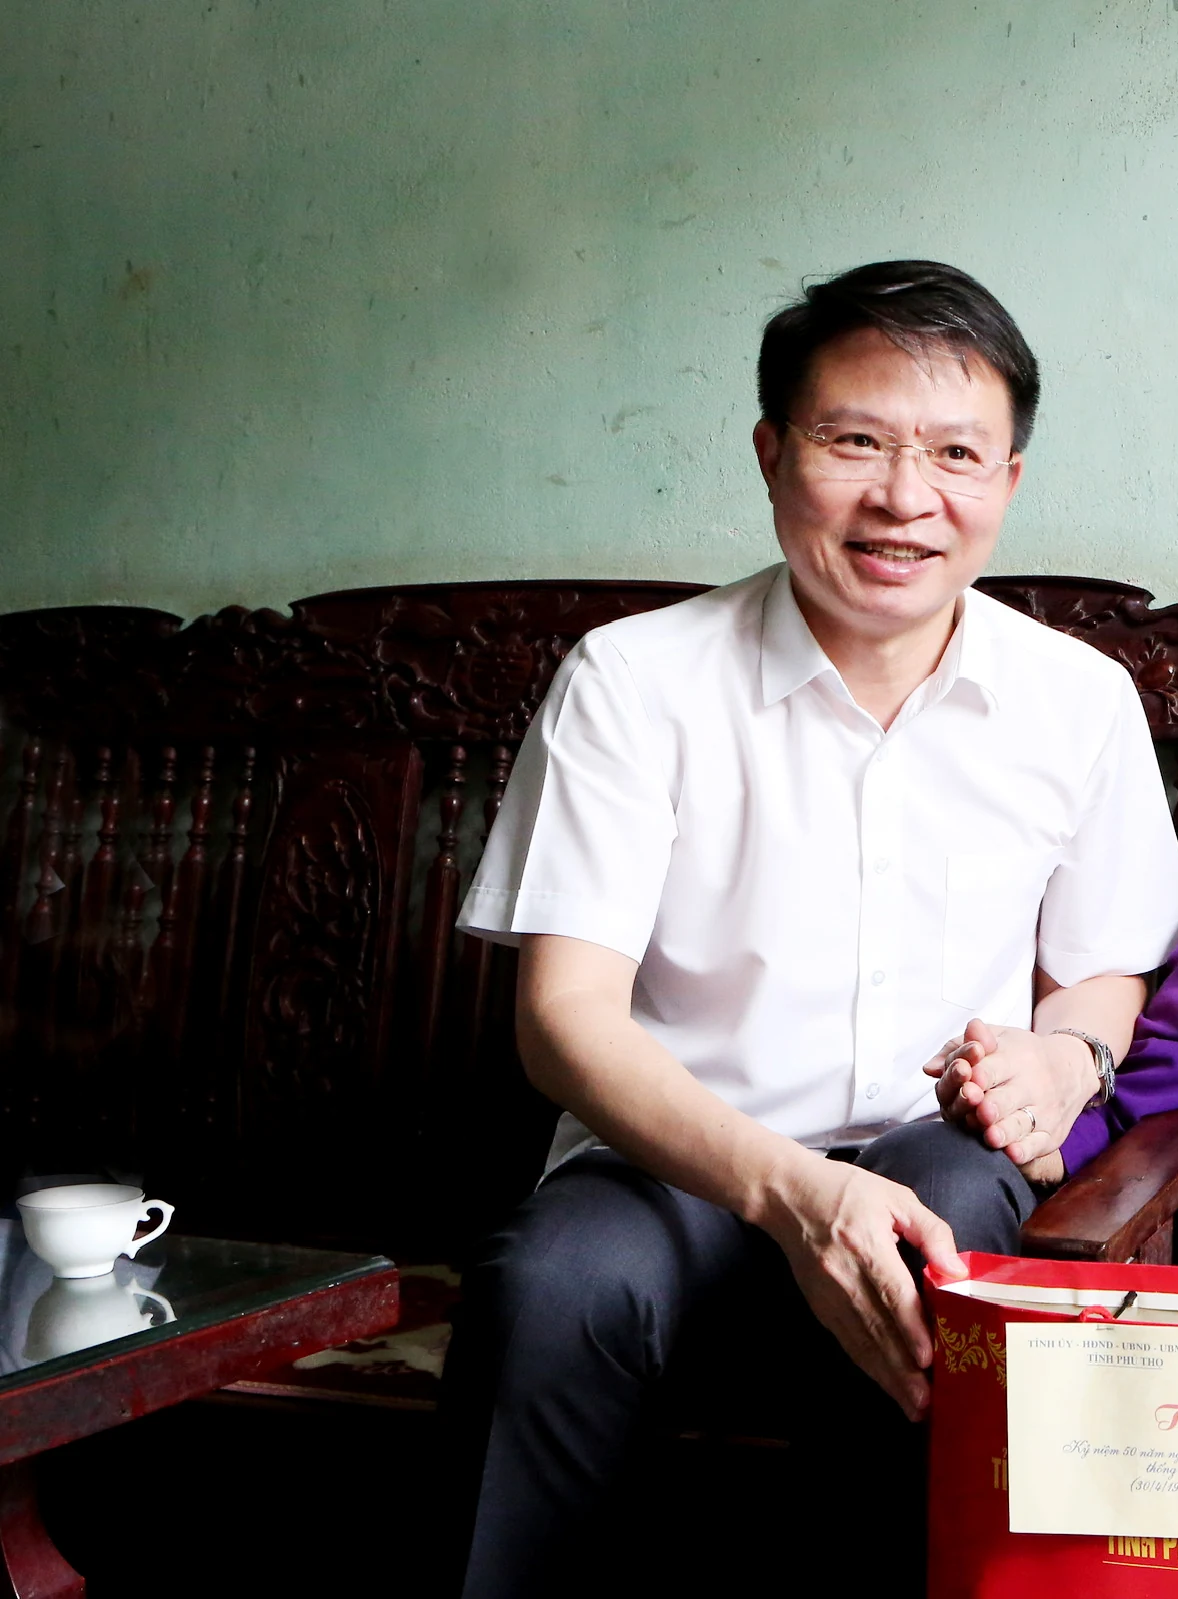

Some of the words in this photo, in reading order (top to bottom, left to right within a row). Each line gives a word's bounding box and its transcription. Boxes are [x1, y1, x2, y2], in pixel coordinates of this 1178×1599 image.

[1083, 1340, 1114, 1349] HĐND
[1122, 1343, 1151, 1351] UBND
[1093, 1445, 1119, 1457] niệm
[1123, 1446, 1137, 1456] 50
[1140, 1448, 1164, 1458] năm
[1146, 1461, 1177, 1479] thống
